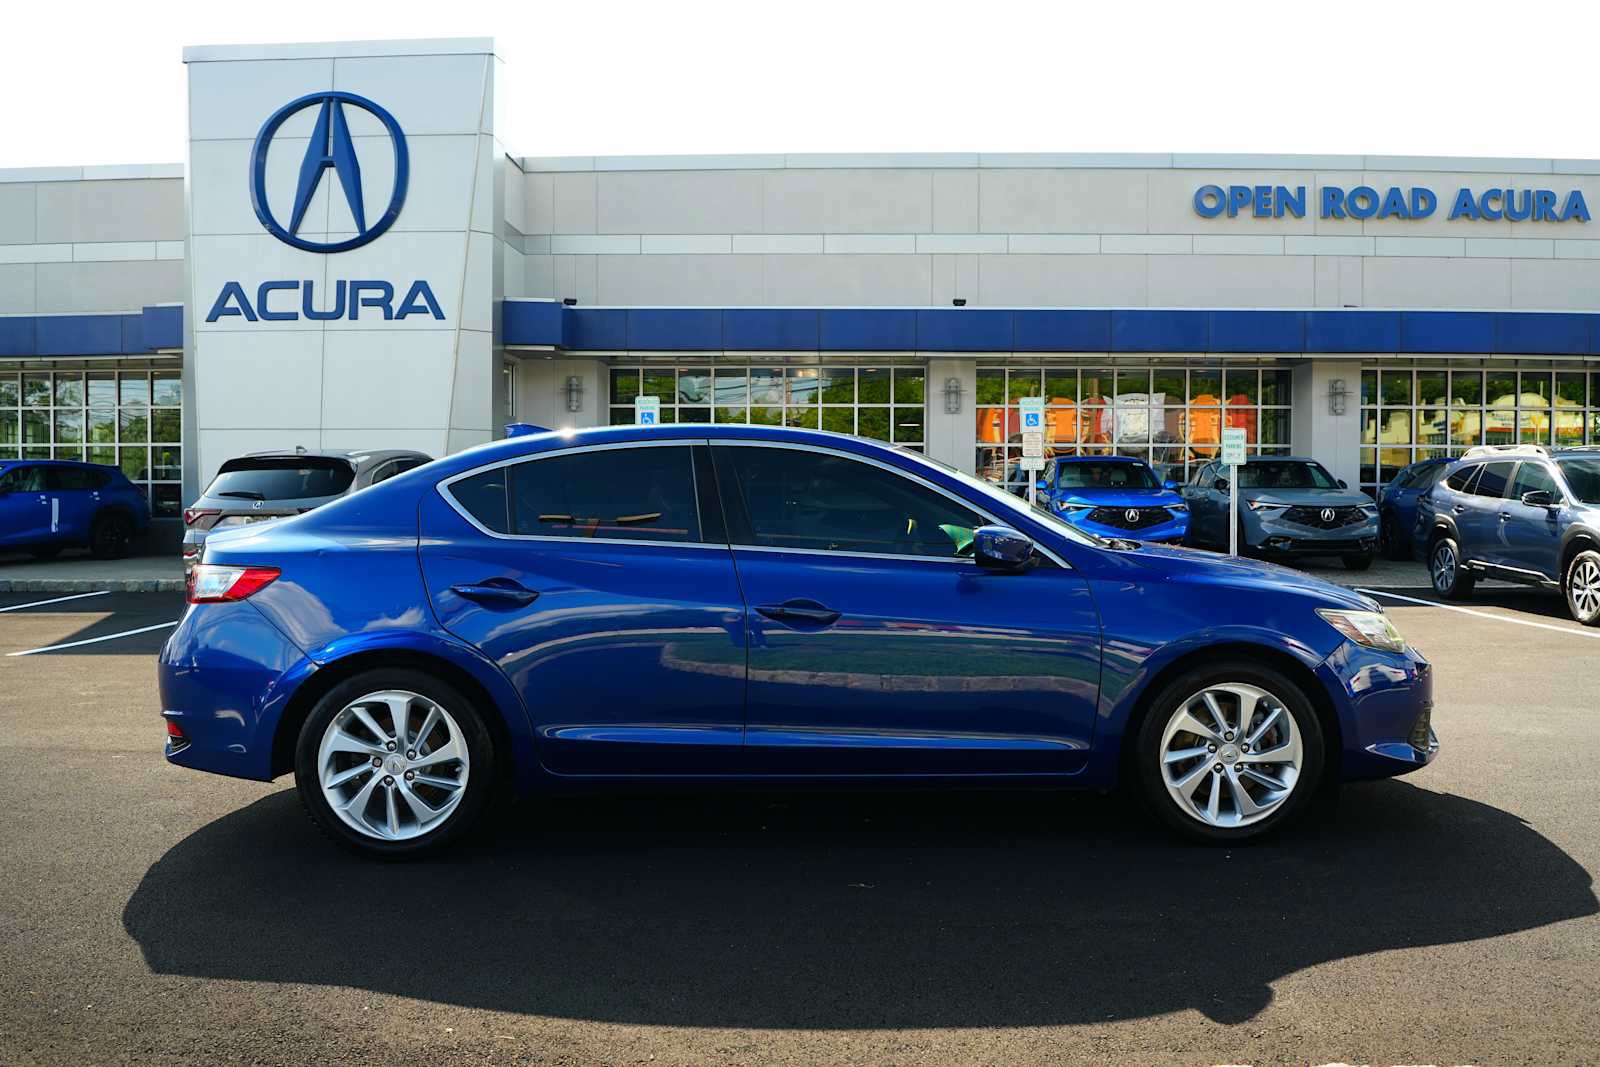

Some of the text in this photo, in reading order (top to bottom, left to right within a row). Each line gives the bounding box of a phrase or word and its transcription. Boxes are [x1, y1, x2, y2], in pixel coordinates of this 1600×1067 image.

[1194, 185, 1591, 221] OPEN ROAD ACURA
[206, 280, 446, 322] ACURA
